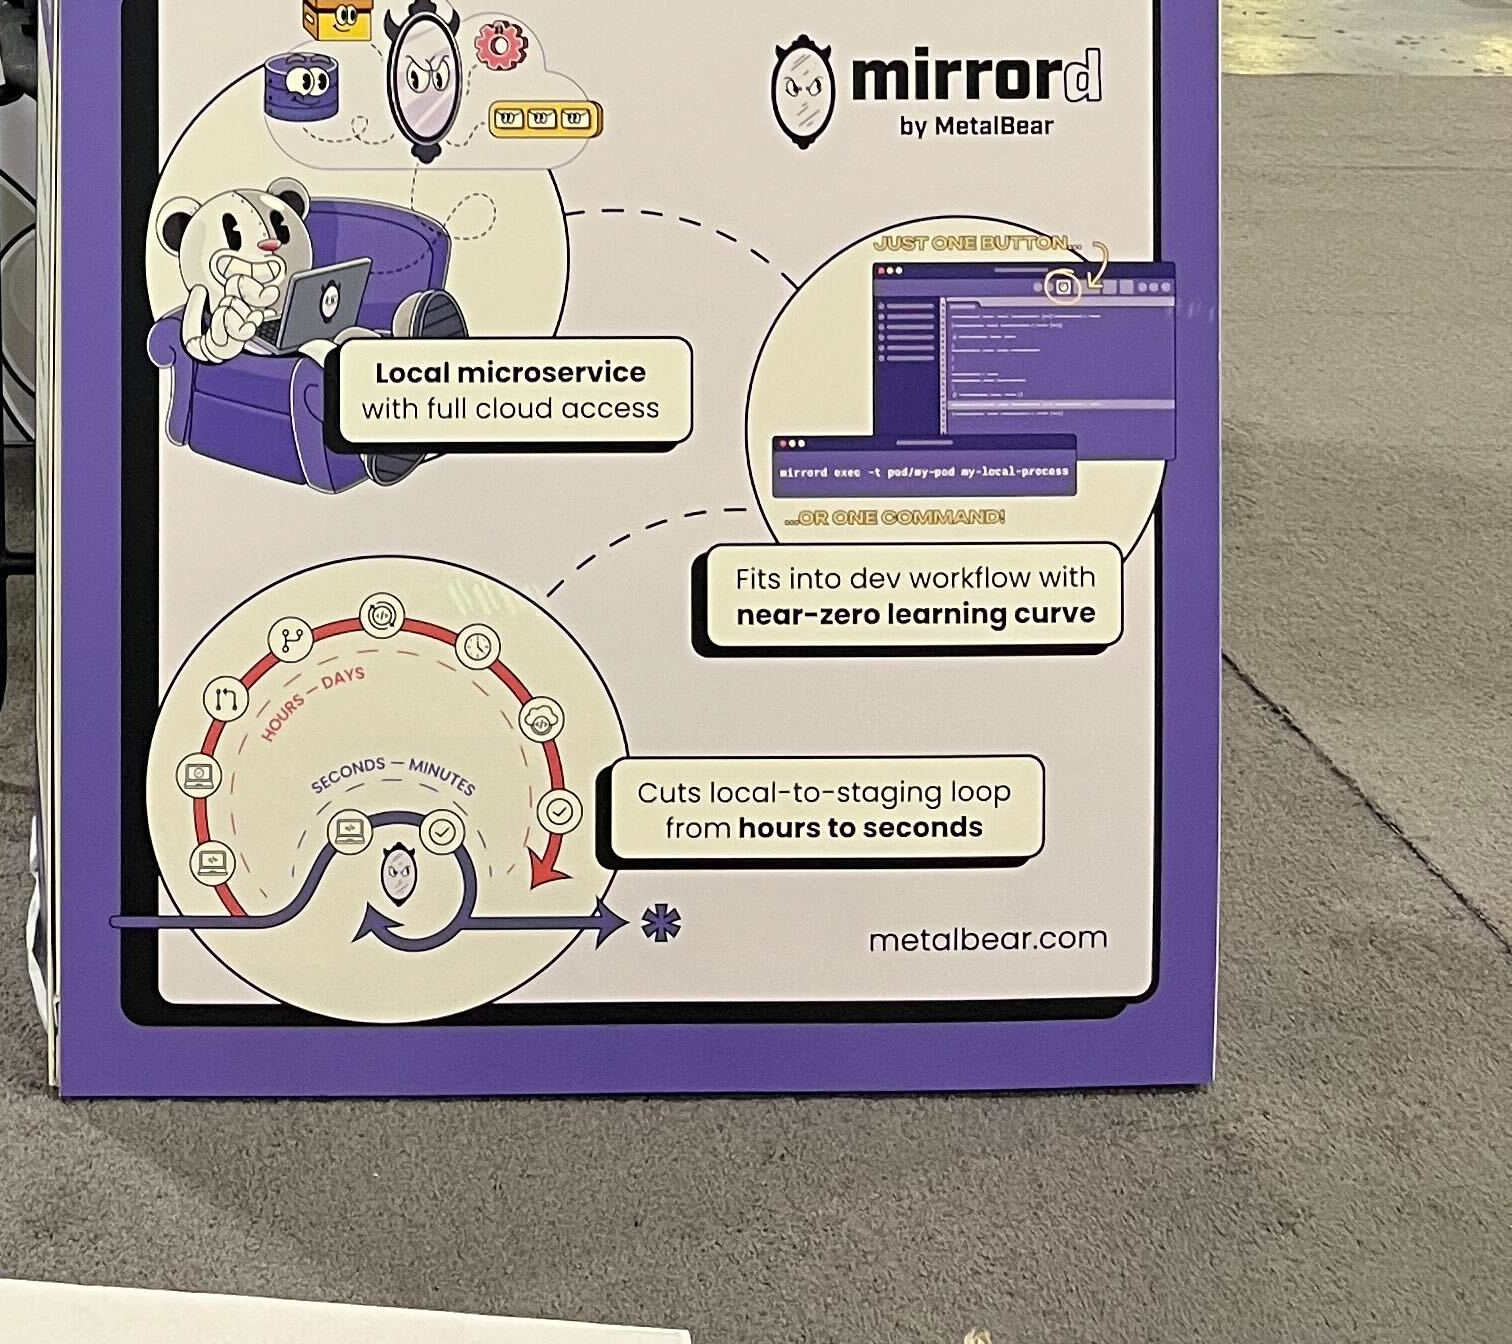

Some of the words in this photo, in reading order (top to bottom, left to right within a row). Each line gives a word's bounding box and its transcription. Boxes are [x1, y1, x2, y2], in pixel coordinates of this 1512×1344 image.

[853, 47, 1102, 102] mirrord
[901, 116, 927, 139] by
[936, 116, 1054, 135] MetalBear
[873, 236, 929, 251] JUST
[931, 236, 977, 251] ONE
[377, 362, 449, 383] Local
[459, 360, 645, 383] microservice
[362, 397, 417, 419] with
[428, 397, 465, 419] full
[477, 397, 551, 418] cloud
[563, 402, 658, 418] access
[779, 467, 828, 478] mirrord
[833, 469, 861, 478] exec
[832, 510, 878, 525] ONE
[881, 509, 1006, 525] COMMAND!
[738, 568, 780, 589] Fits
[791, 567, 840, 589] into
[851, 567, 900, 588] dev
[910, 566, 1030, 588] workflow
[1039, 566, 1094, 587] with
[738, 608, 880, 625] near-zero
[889, 601, 1006, 631] learning
[1015, 607, 1095, 623] curve
[261, 694, 305, 742] HOURS
[321, 667, 366, 690] DAYS
[311, 757, 386, 794] SECONDS
[408, 758, 476, 797] MINUTES
[639, 783, 700, 803] Cuts
[711, 780, 941, 809] local-to-staging
[953, 781, 1010, 808] loop
[667, 817, 730, 838] from
[740, 817, 820, 838] hours
[829, 818, 855, 837] to
[864, 816, 982, 837] seconds
[871, 928, 1106, 951] metalbear.com
